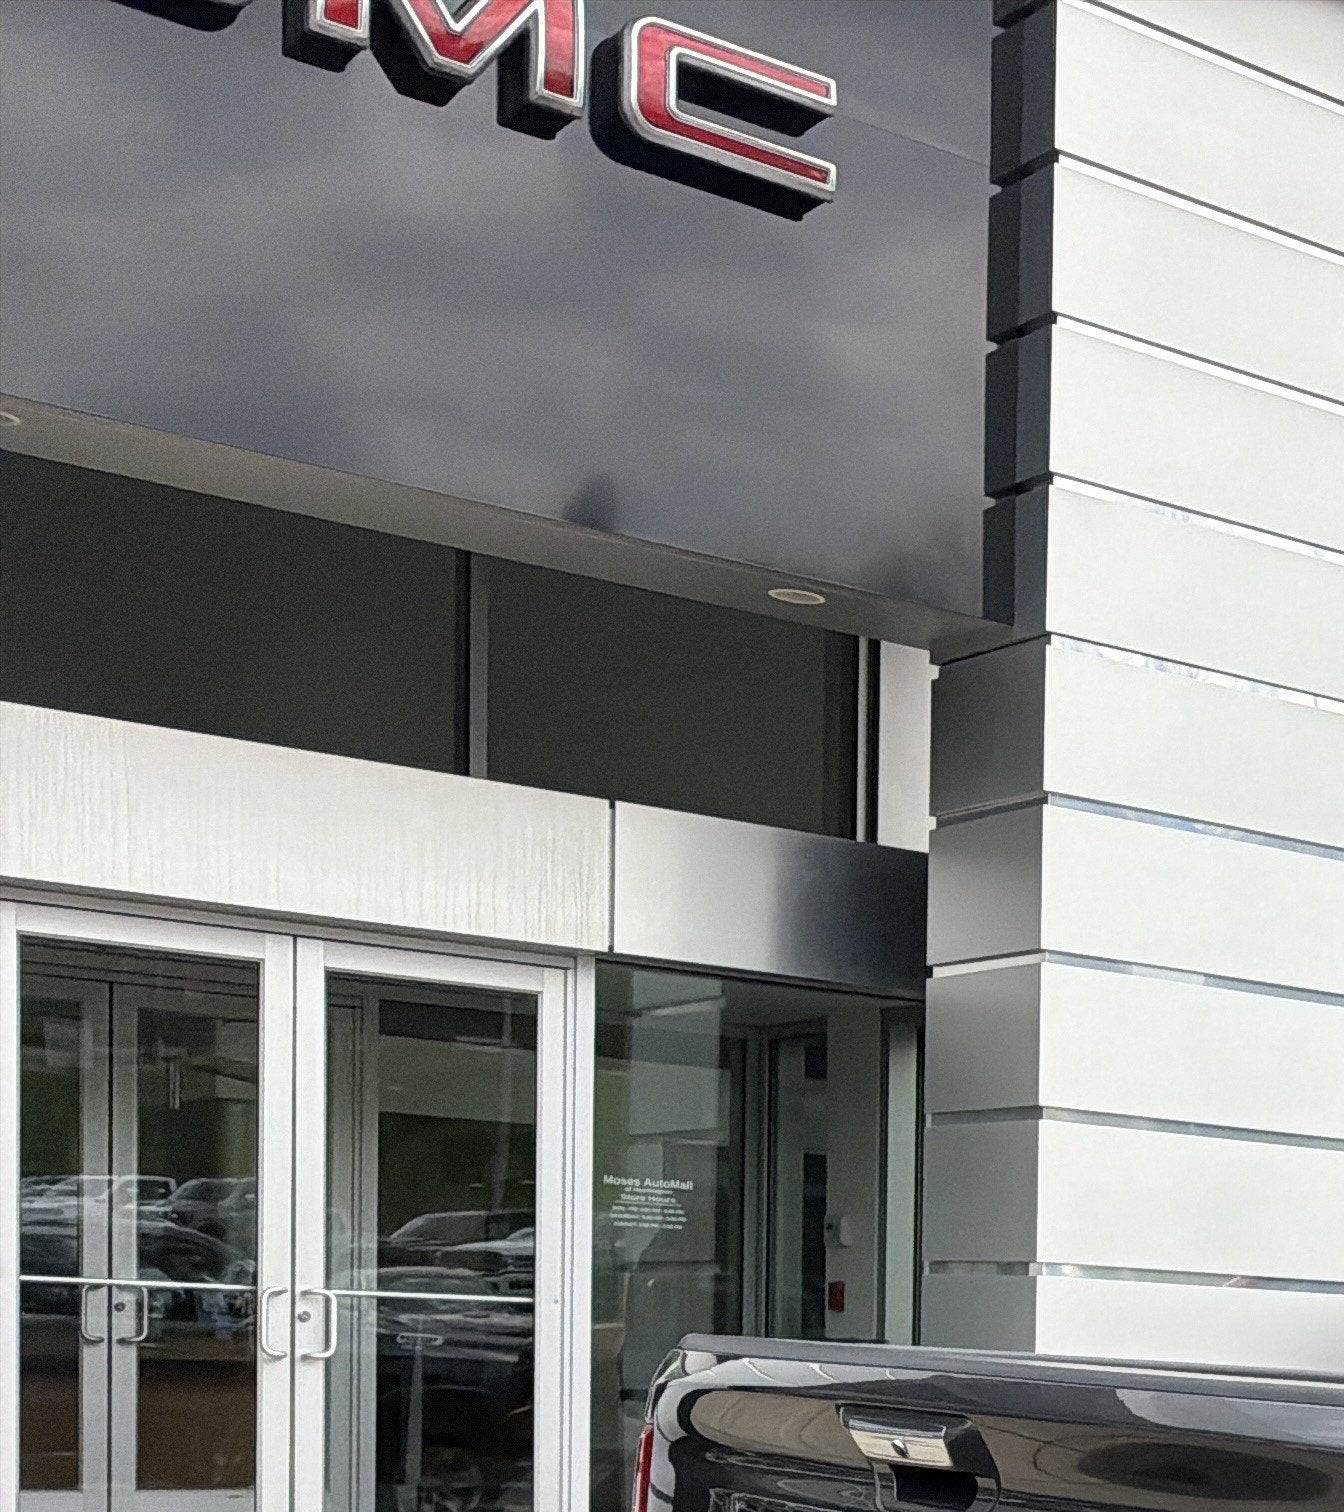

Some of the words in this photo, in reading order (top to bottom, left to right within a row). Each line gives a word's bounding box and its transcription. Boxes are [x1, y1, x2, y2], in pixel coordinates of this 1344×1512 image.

[200, 0, 836, 208] MC
[603, 1174, 641, 1187] Moses
[643, 1177, 694, 1191] AutoMall
